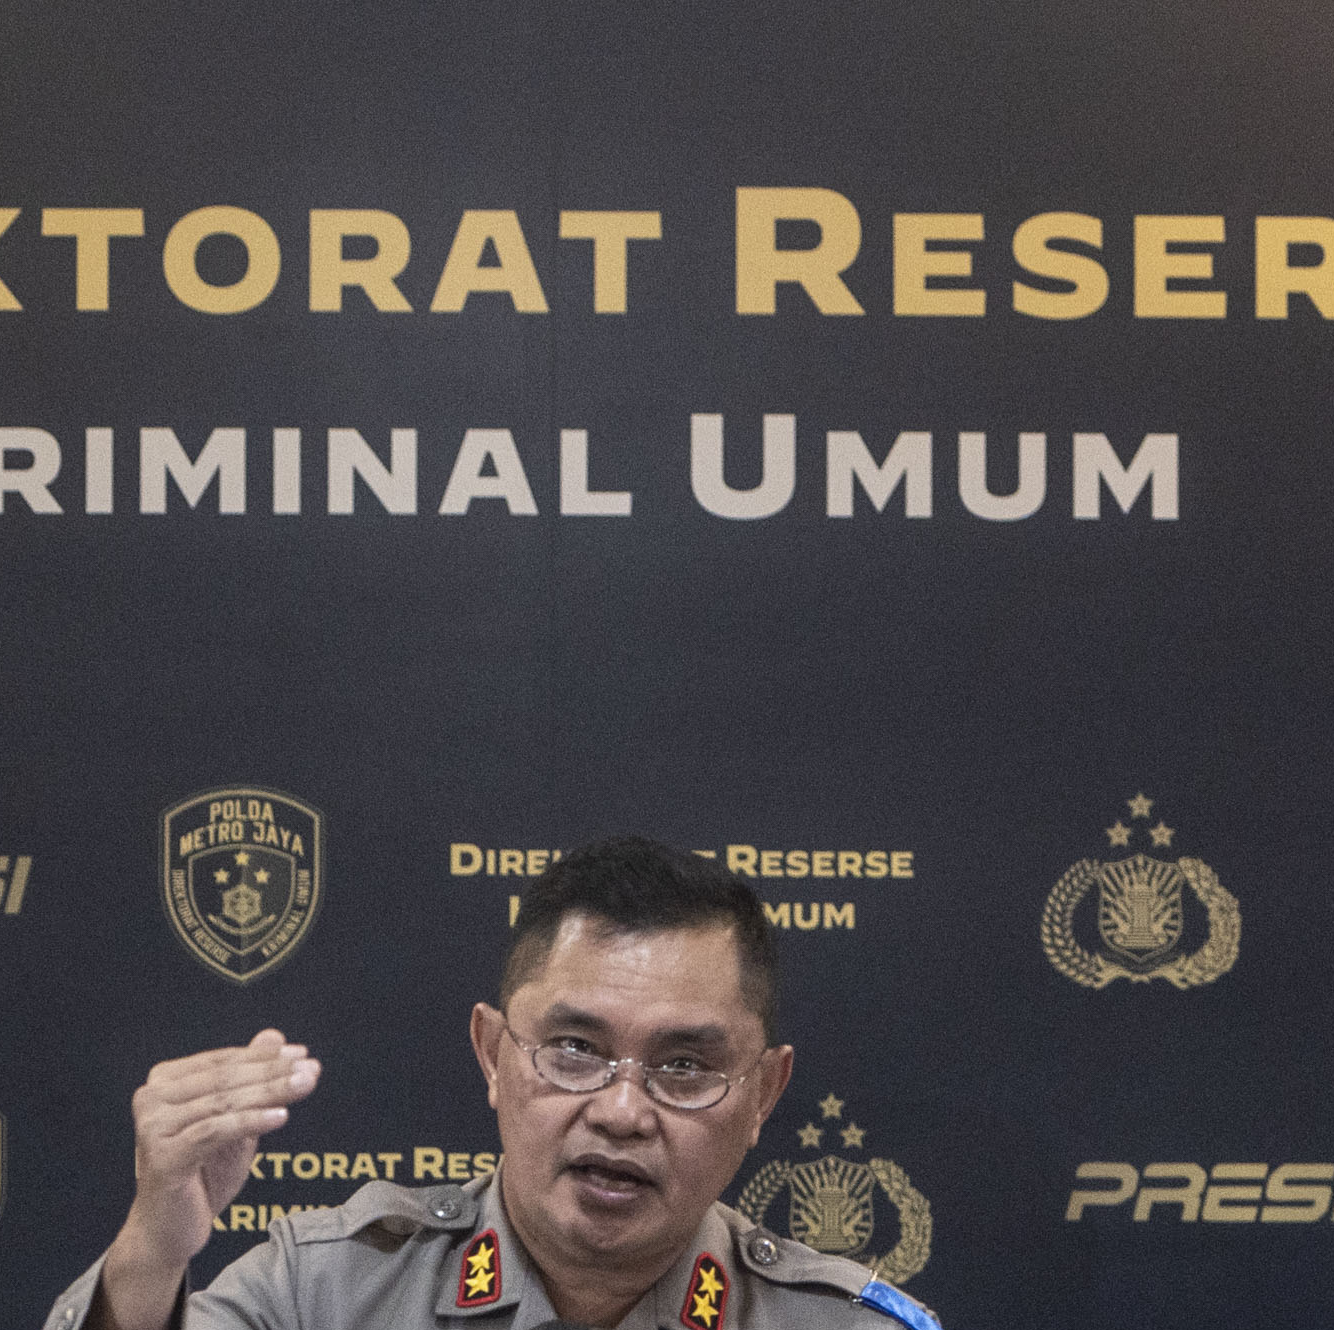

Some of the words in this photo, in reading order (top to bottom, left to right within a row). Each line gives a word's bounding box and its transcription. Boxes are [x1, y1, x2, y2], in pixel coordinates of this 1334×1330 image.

[690, 412, 1179, 522] UMUM
[209, 800, 275, 824] POLDA
[179, 821, 244, 856] METRO
[253, 822, 304, 857] JAYA
[765, 902, 856, 930] MUM
